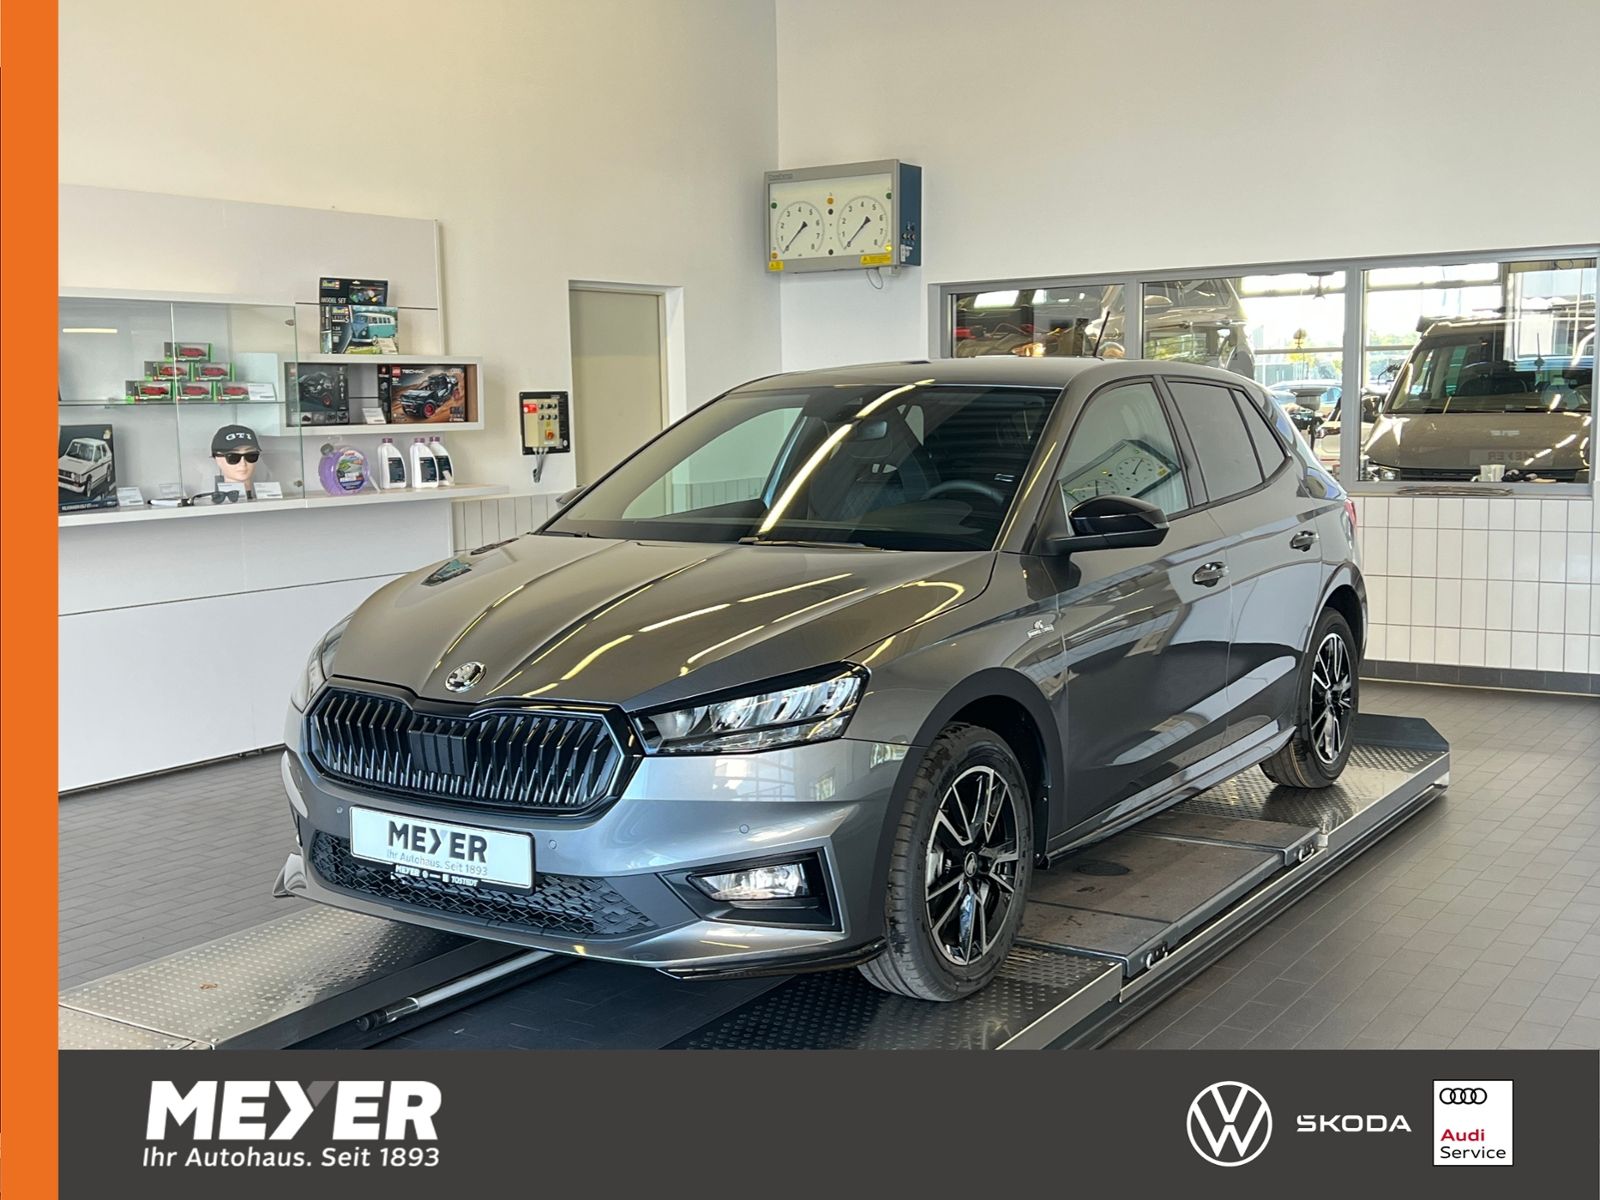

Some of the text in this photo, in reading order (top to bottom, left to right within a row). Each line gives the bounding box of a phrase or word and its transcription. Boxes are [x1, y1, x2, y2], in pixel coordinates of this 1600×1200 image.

[225, 432, 252, 441] GTI
[388, 821, 488, 863] MEYER
[387, 849, 488, 876] Ihr Autohaus. Seit 1893
